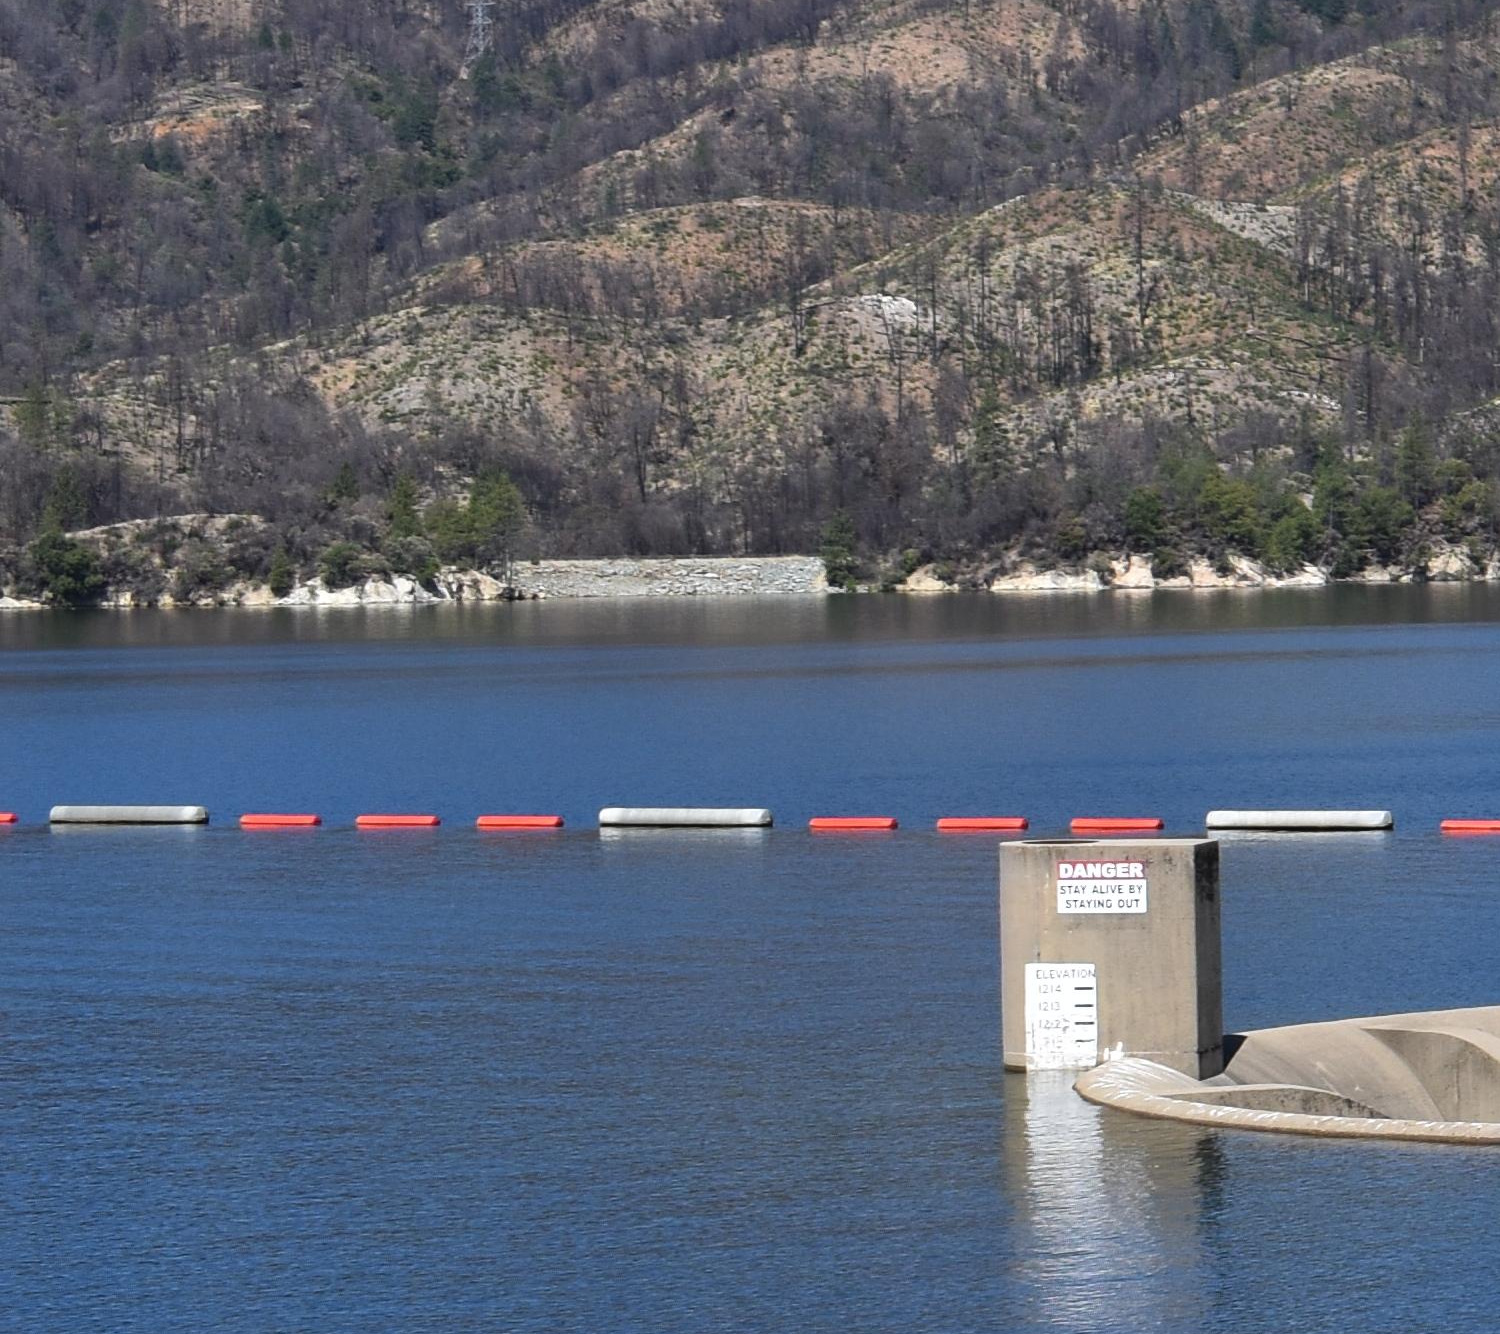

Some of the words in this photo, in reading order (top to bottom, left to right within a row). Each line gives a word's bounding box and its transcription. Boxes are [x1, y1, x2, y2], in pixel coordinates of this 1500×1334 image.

[1059, 863, 1144, 878] DANGER
[1060, 884, 1086, 895] STAY
[1092, 884, 1123, 895] ALIVE
[1129, 883, 1143, 895] BY
[1065, 899, 1112, 909] STAYING
[1118, 898, 1140, 909] OUT
[1036, 968, 1097, 980] ELEVATION
[1038, 984, 1062, 994] 1214
[1038, 1001, 1061, 1011] 1213
